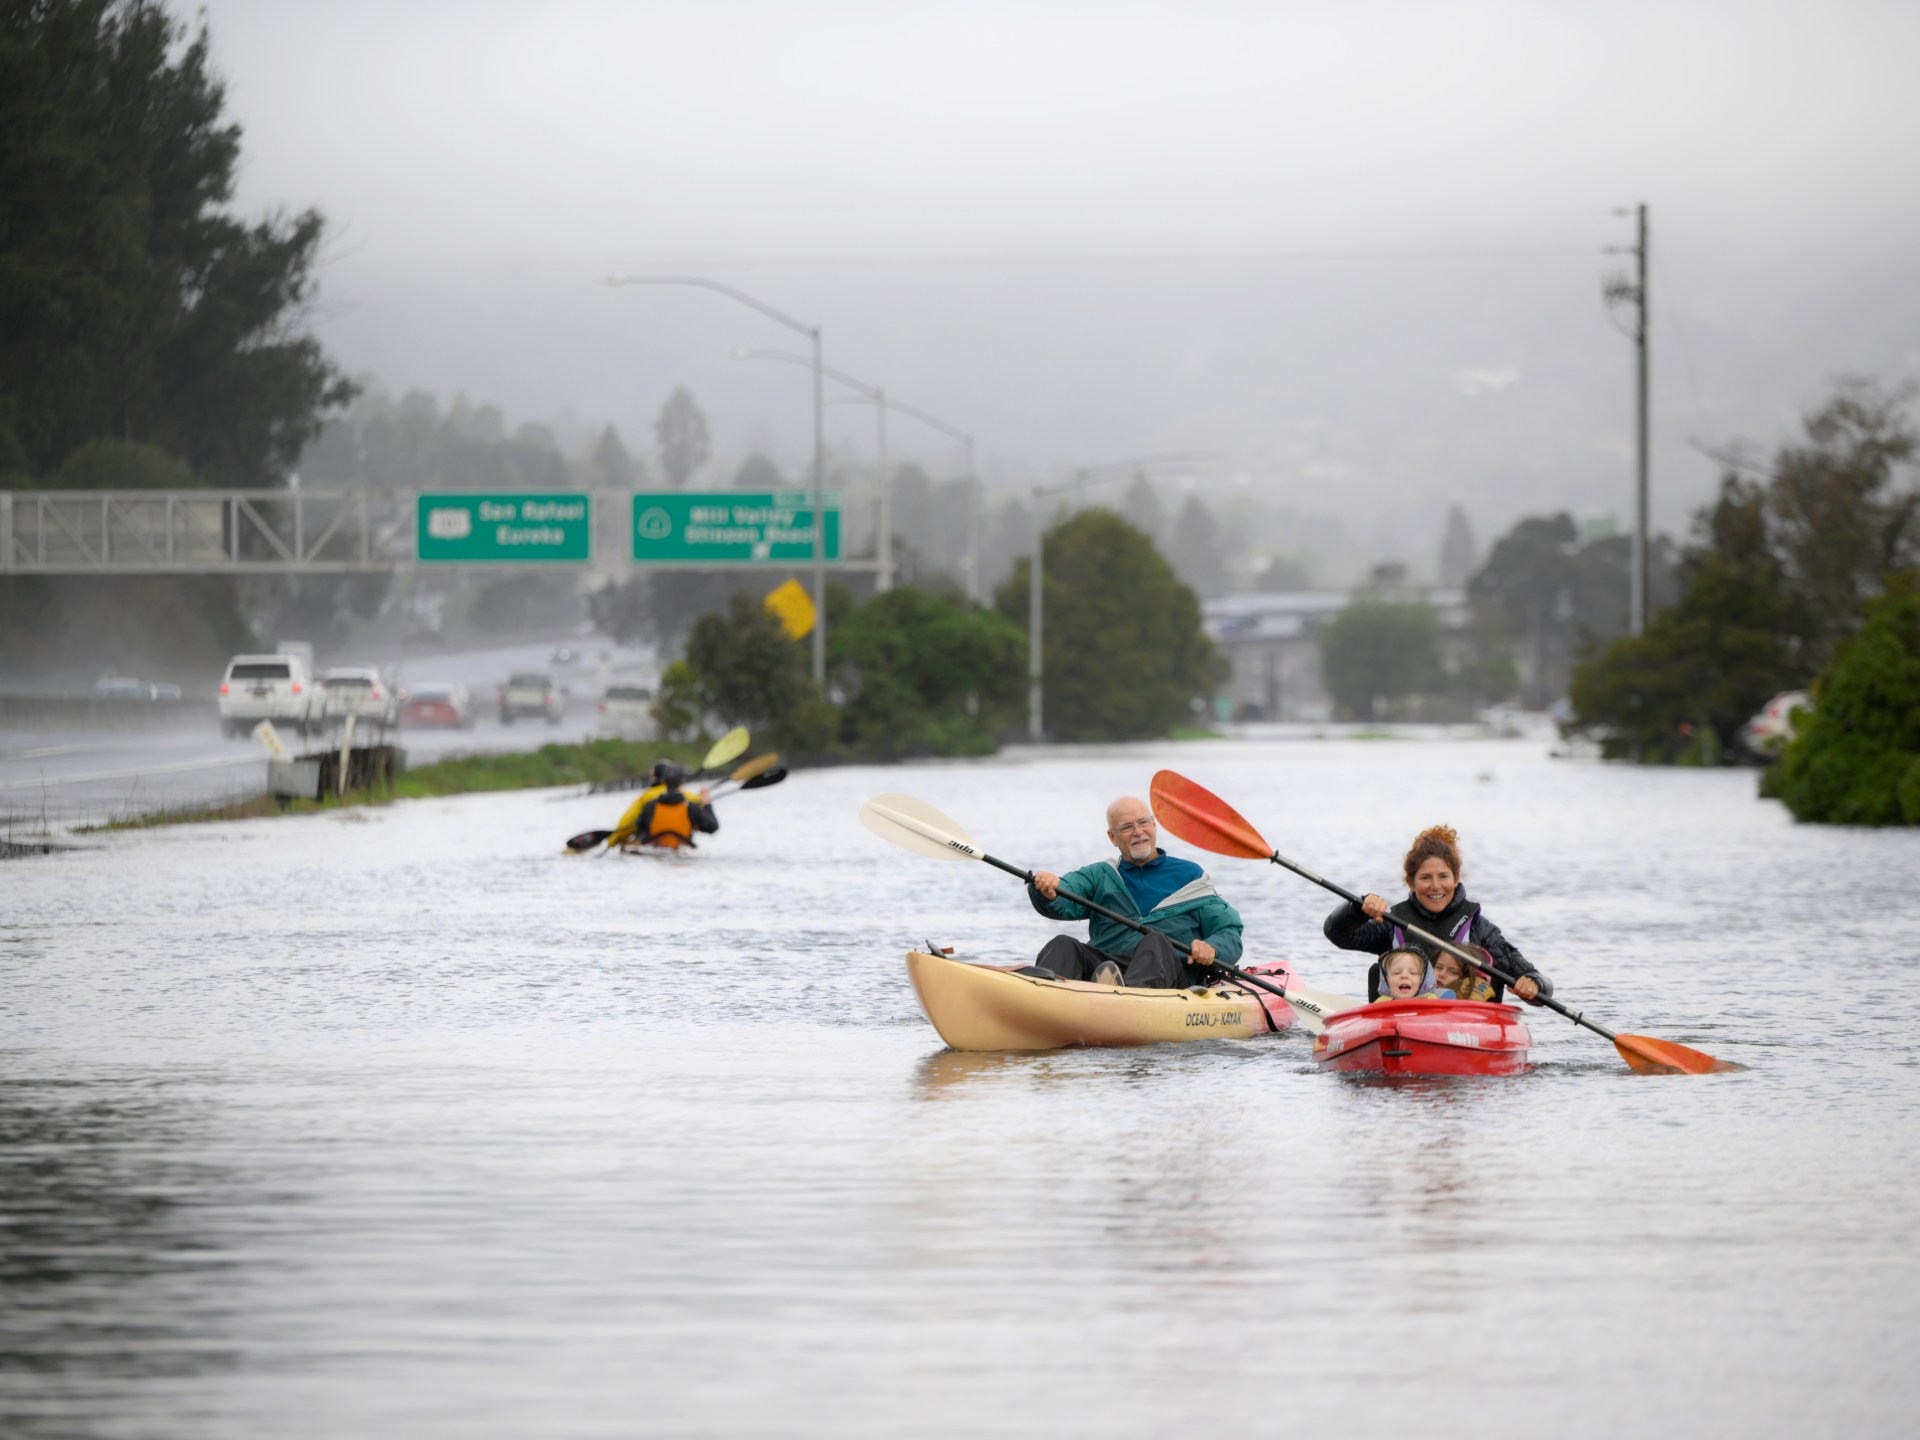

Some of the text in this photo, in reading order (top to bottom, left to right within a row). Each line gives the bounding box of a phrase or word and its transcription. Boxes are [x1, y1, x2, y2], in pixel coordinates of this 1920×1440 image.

[479, 502, 584, 521] San Rafael
[689, 506, 796, 526] Mill Valley
[496, 525, 565, 545] Eureka
[684, 526, 820, 544] Stinson Beac
[1185, 1011, 1242, 1026] OCEAN KAYAK
